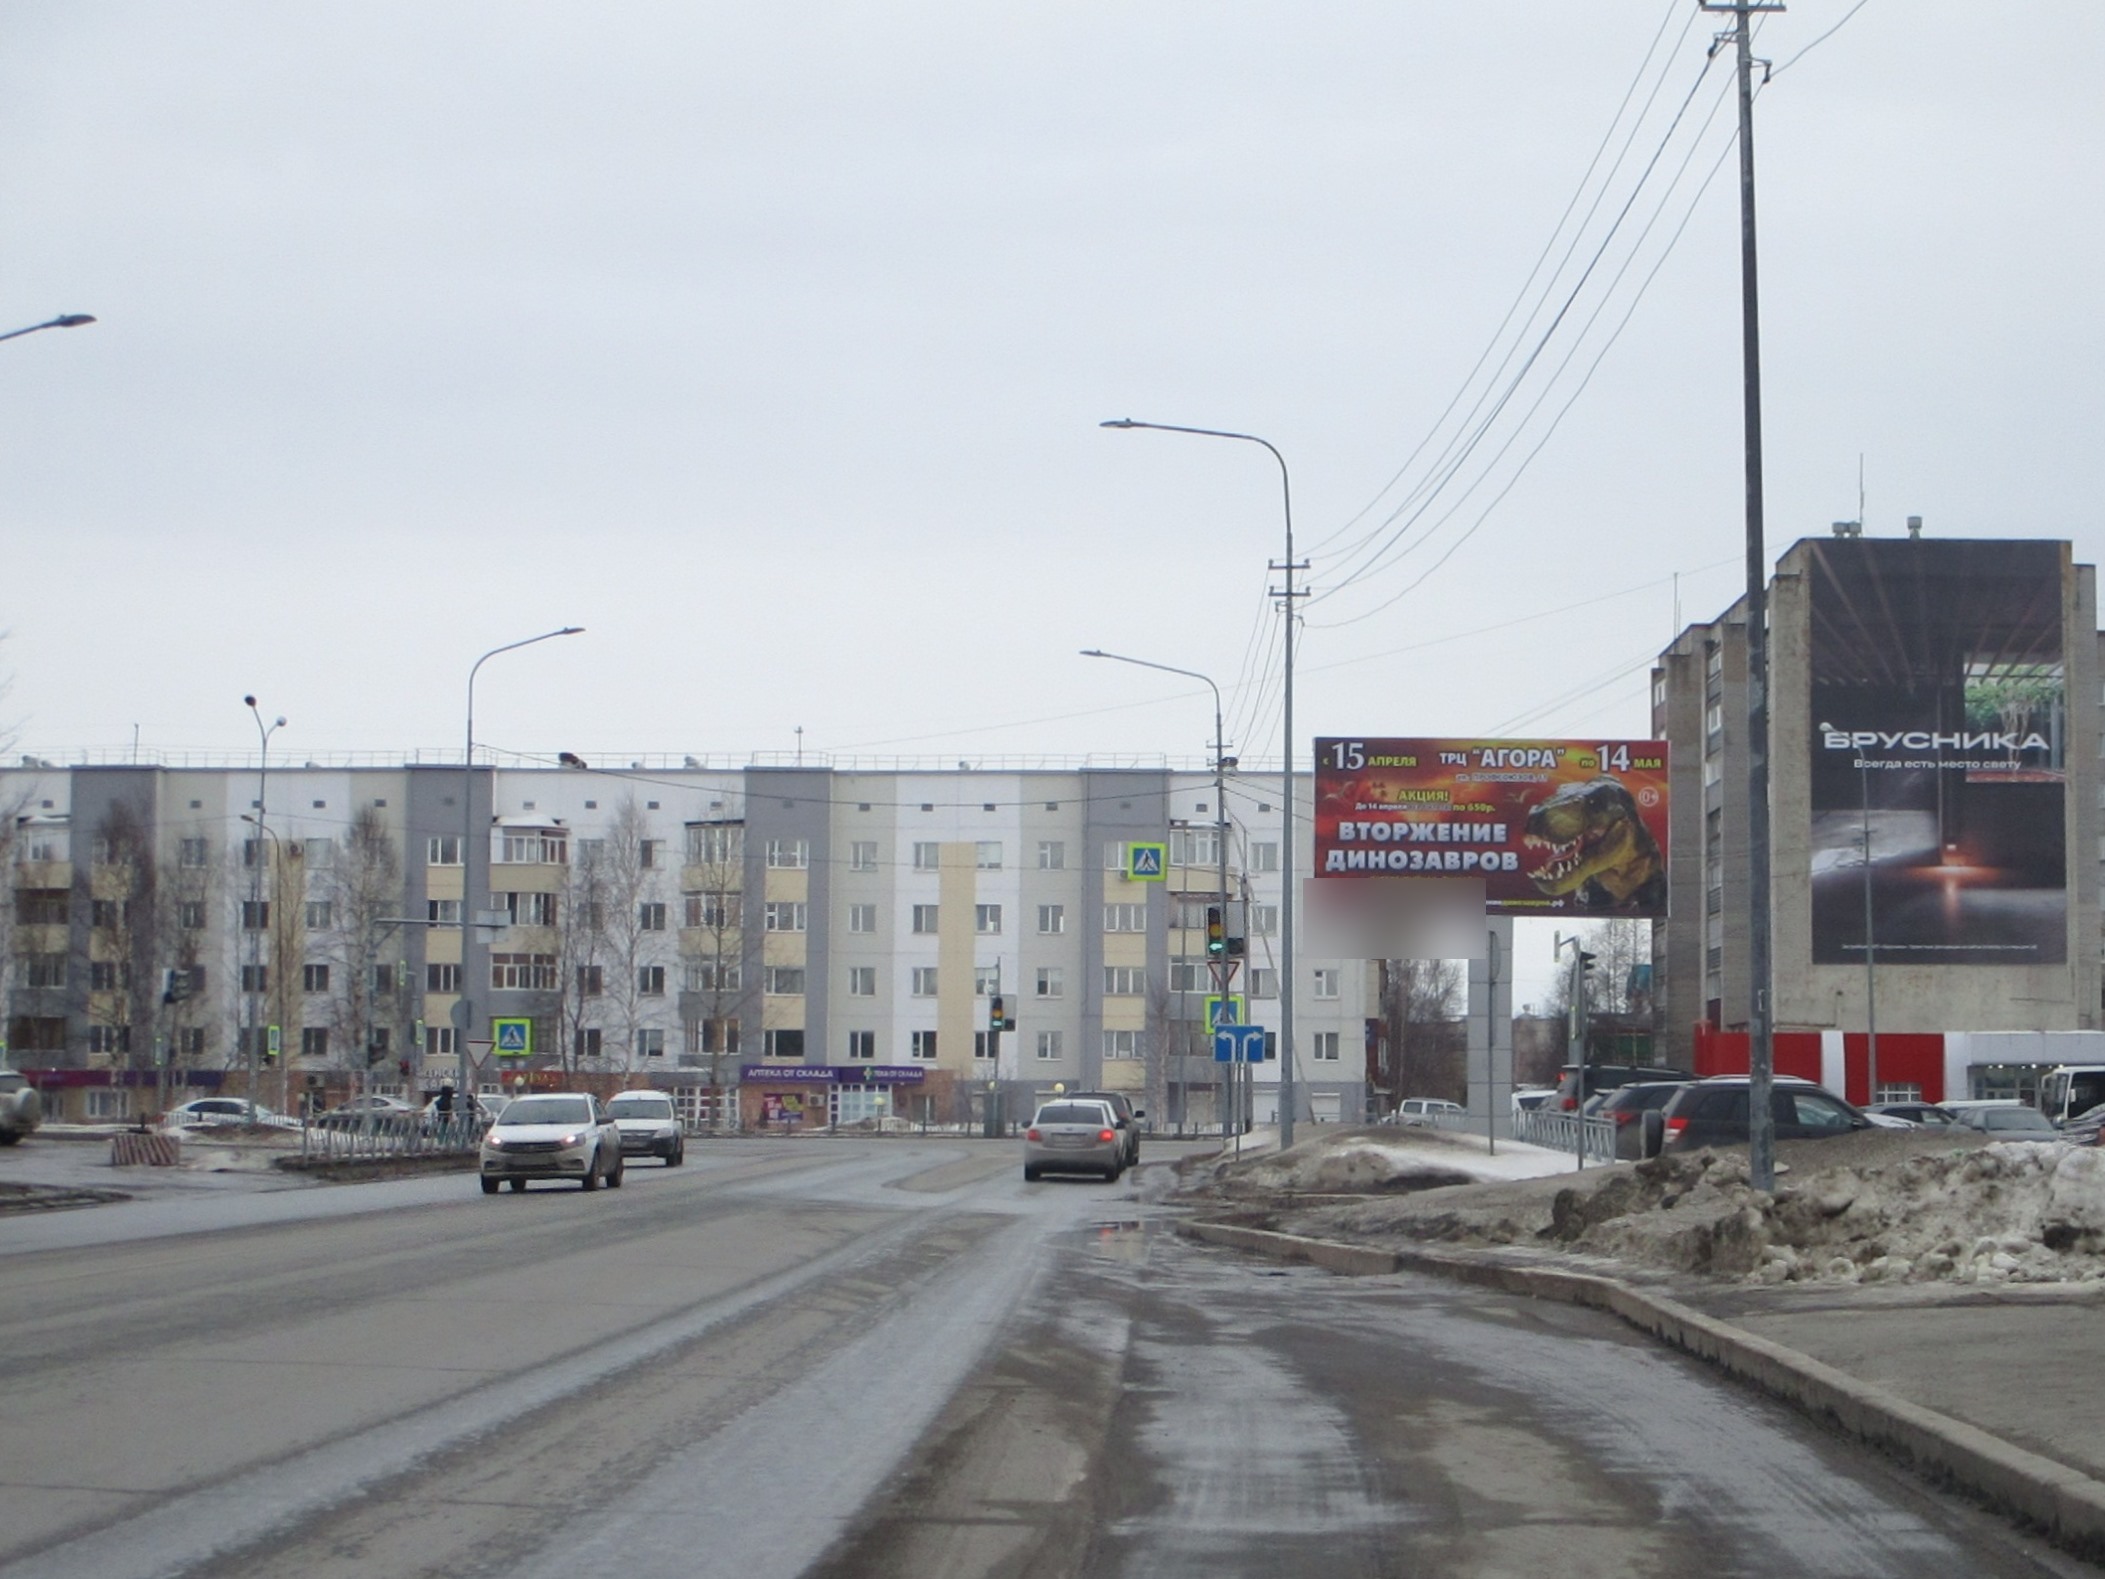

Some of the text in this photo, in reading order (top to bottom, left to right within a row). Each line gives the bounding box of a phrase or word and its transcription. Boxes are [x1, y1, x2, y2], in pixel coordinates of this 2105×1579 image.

[1823, 731, 2050, 750] БРУСНИКА
[1332, 742, 1364, 770] 15
[1367, 756, 1417, 767] АПРЕЛЯ
[1439, 752, 1467, 767] ТРЦ
[1580, 744, 1661, 772] по 14 МАЯ
[1853, 758, 2021, 770] Всегда есть место свету
[1397, 789, 1450, 802] АКЦИЯ!
[1452, 804, 1466, 812] по
[1338, 821, 1507, 843] ВТОРЖЕНИЕ
[1324, 849, 1519, 872] ДИНОЗАВРОВ
[747, 1069, 834, 1078] АПТЕКА ОТ СКЛАДА
